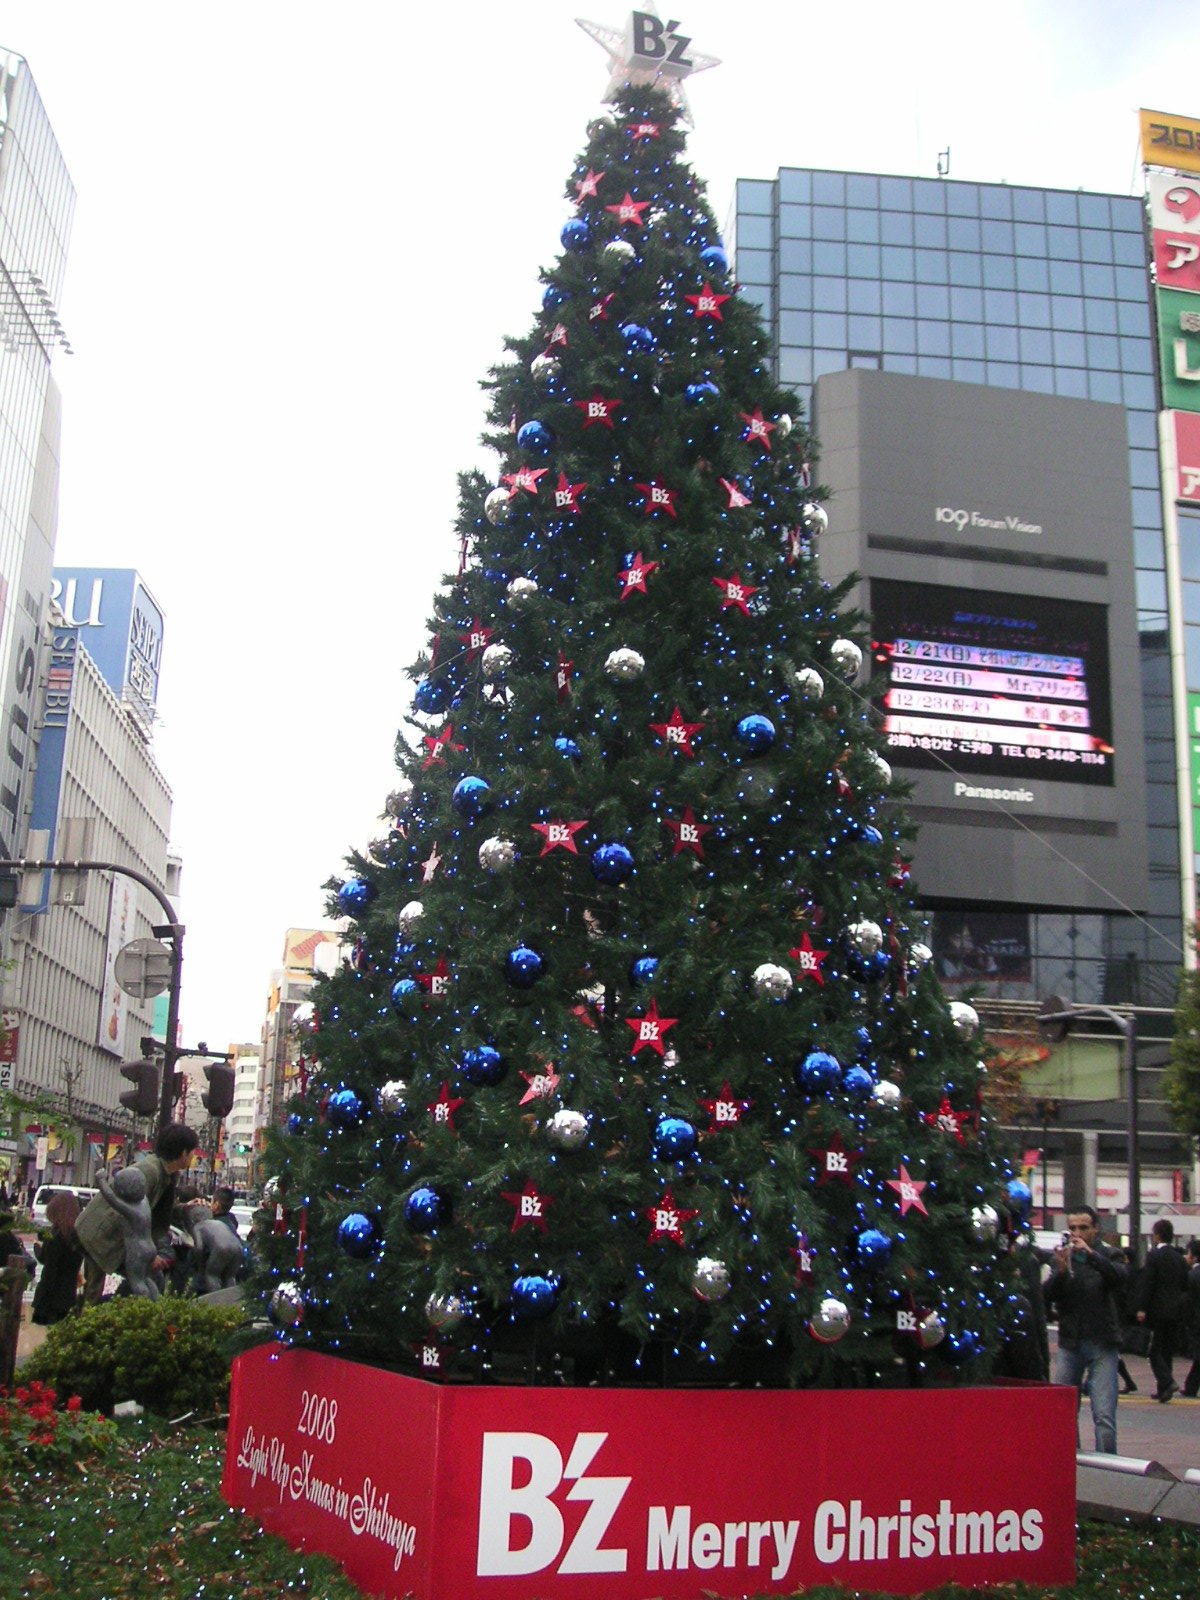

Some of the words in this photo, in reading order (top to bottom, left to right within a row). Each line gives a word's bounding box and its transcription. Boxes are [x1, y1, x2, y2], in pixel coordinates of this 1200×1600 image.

[633, 11, 693, 67] B'z
[1148, 123, 1200, 151] スロ
[699, 296, 717, 312] B'z
[588, 402, 608, 418] B'z
[555, 489, 573, 507] B'z
[651, 488, 671, 504] B'z
[935, 507, 969, 532] 109
[627, 568, 643, 586] B'z
[727, 583, 745, 602] B'z
[470, 631, 487, 649] B'z
[43, 634, 76, 728] SEIBU
[666, 726, 686, 743] B'z
[954, 782, 1034, 802] Panasonic
[549, 825, 570, 842] B'z
[680, 823, 699, 843] B'z
[800, 951, 818, 970] B'z
[639, 1021, 658, 1041] B'z
[716, 1101, 738, 1121] B'z
[826, 1151, 848, 1172] B'z
[521, 1196, 542, 1217] B'z
[655, 1209, 680, 1232] B'z
[897, 1311, 916, 1331] B'z
[298, 1390, 338, 1445] 2008
[237, 1426, 271, 1488] Light
[270, 1437, 290, 1504] Up
[290, 1450, 336, 1513] Xmas
[335, 1477, 350, 1520] in
[350, 1477, 417, 1572] Shibuya
[476, 1431, 632, 1577] B'z
[647, 1505, 800, 1581] Merry
[813, 1499, 1045, 1565] Christmas
